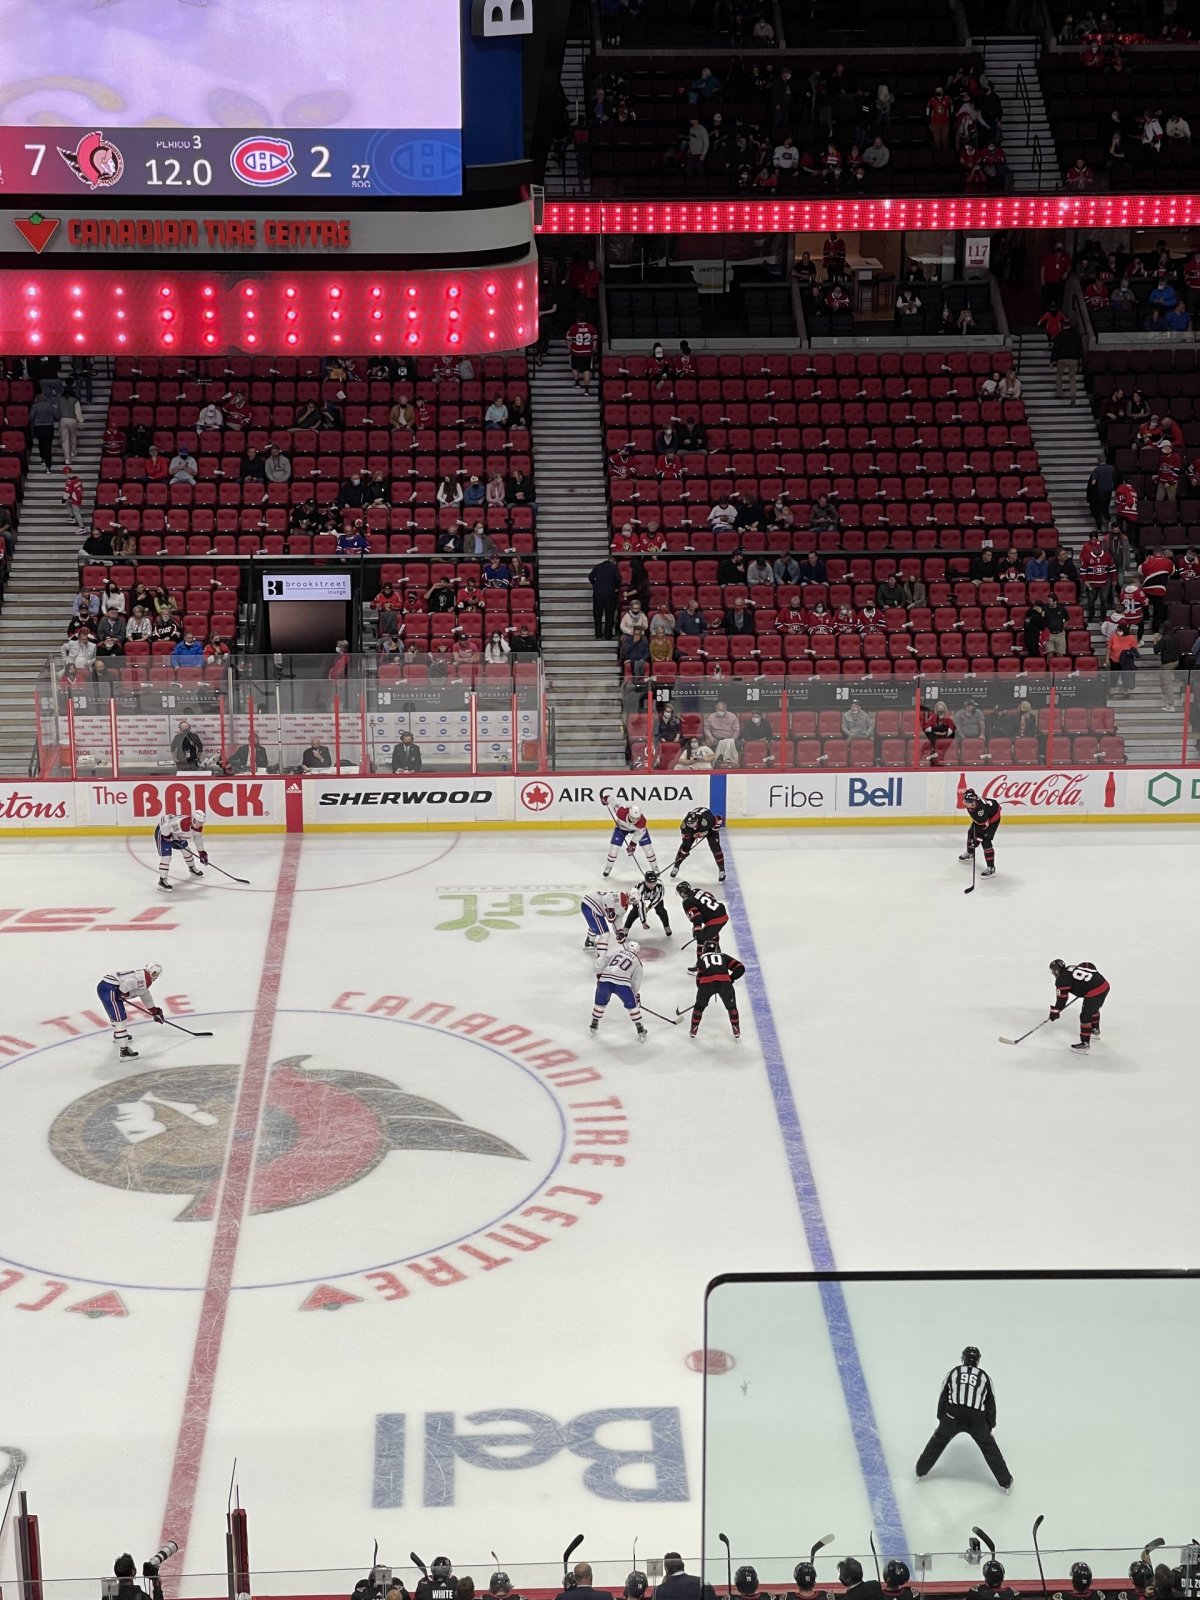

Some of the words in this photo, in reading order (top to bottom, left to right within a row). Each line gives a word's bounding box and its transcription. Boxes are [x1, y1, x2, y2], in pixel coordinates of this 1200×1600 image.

[192, 135, 202, 149] 3
[24, 144, 46, 176] 7
[145, 159, 212, 186] 12.0
[310, 145, 332, 178] 2
[351, 165, 370, 179] 27
[67, 219, 199, 247] CANADIAN
[202, 219, 257, 248] TIRE
[263, 219, 351, 248] CENTRE
[967, 245, 989, 257] 117
[576, 333, 591, 345] 92
[93, 786, 128, 805] The
[133, 782, 264, 818] BRICK
[319, 790, 493, 806] SHERWOOD
[558, 787, 594, 802] AIR
[599, 786, 693, 803] CANADA
[769, 785, 823, 808] Fibe
[848, 777, 903, 807] Bell
[981, 773, 1089, 807] Coca-Cola
[434, 892, 583, 931] GFL
[609, 955, 632, 971] 60
[703, 954, 723, 968] 10
[40, 994, 195, 1036] TIRE
[331, 991, 603, 1087] CANADIAN
[568, 1095, 629, 1168] TIRE
[365, 1185, 603, 1301] CENTRE
[960, 1373, 977, 1386] 96
[371, 1406, 690, 1509] Bell
[432, 1590, 454, 1600] WHITE
